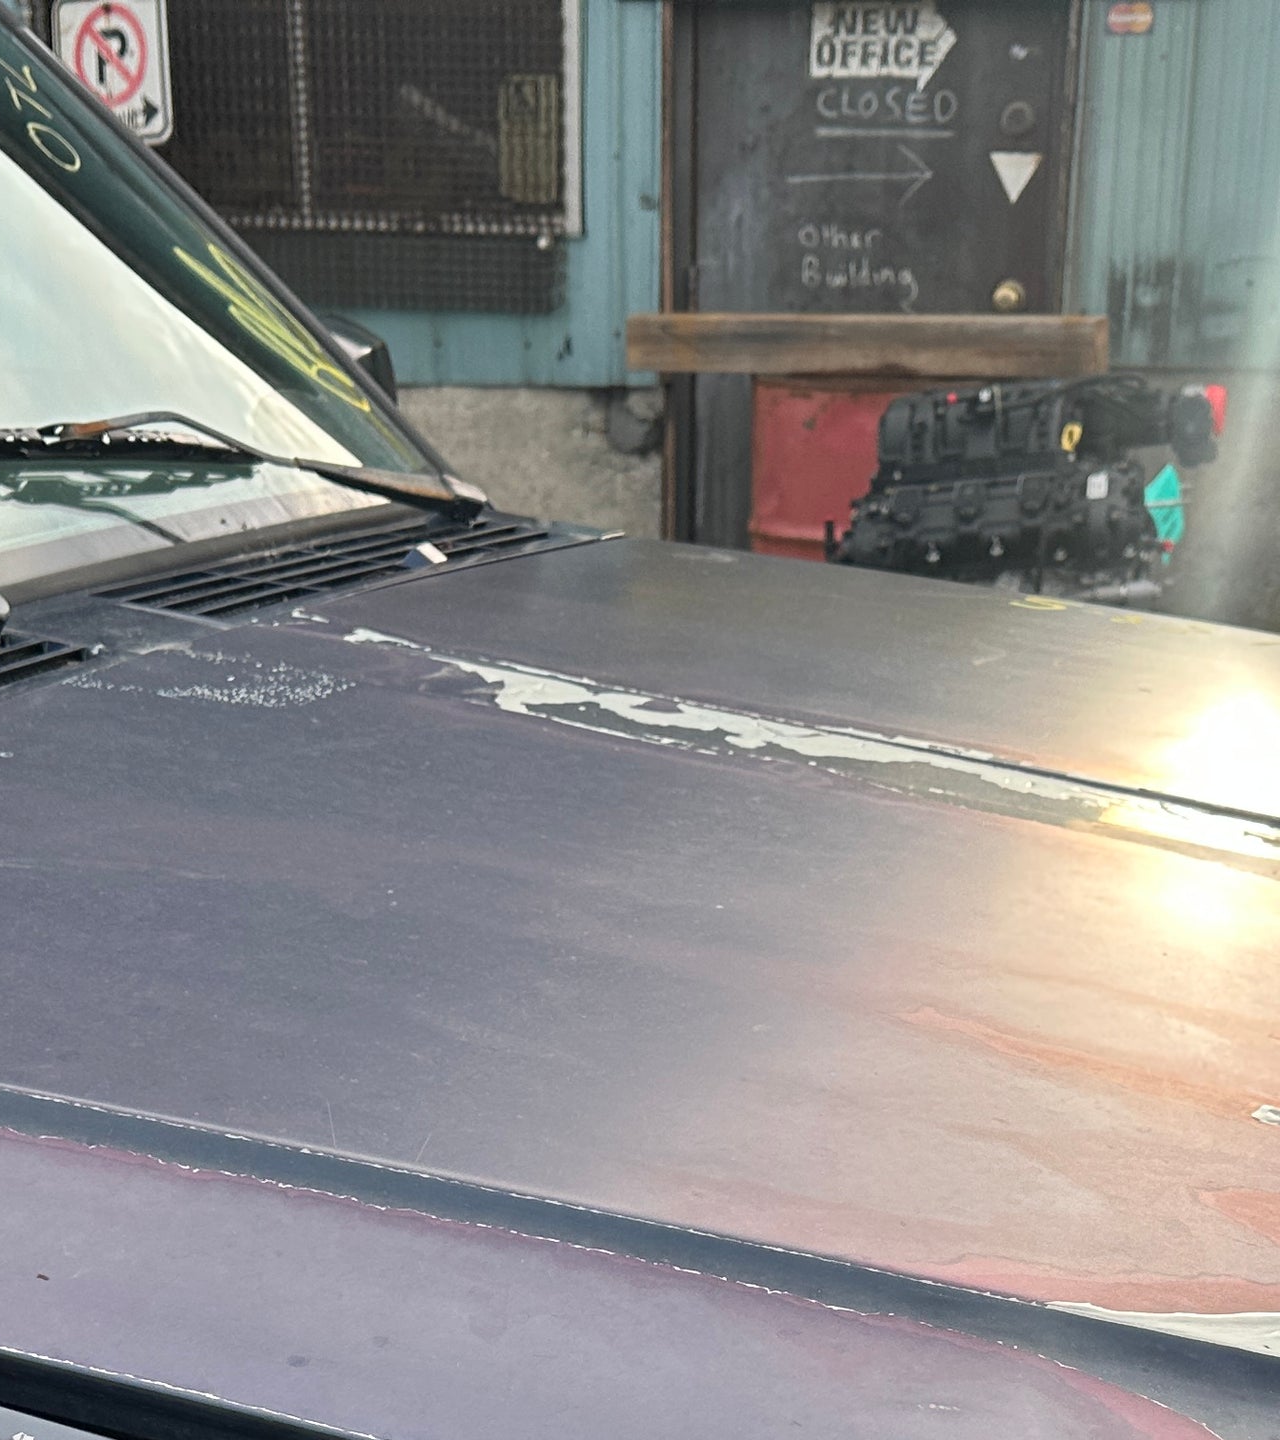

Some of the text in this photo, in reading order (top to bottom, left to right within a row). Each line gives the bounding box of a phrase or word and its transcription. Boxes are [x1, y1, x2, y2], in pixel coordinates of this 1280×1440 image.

[832, 8, 919, 34] NEW
[817, 36, 936, 67] OFFICE
[817, 86, 958, 123] CLOSED
[798, 223, 883, 248] Other
